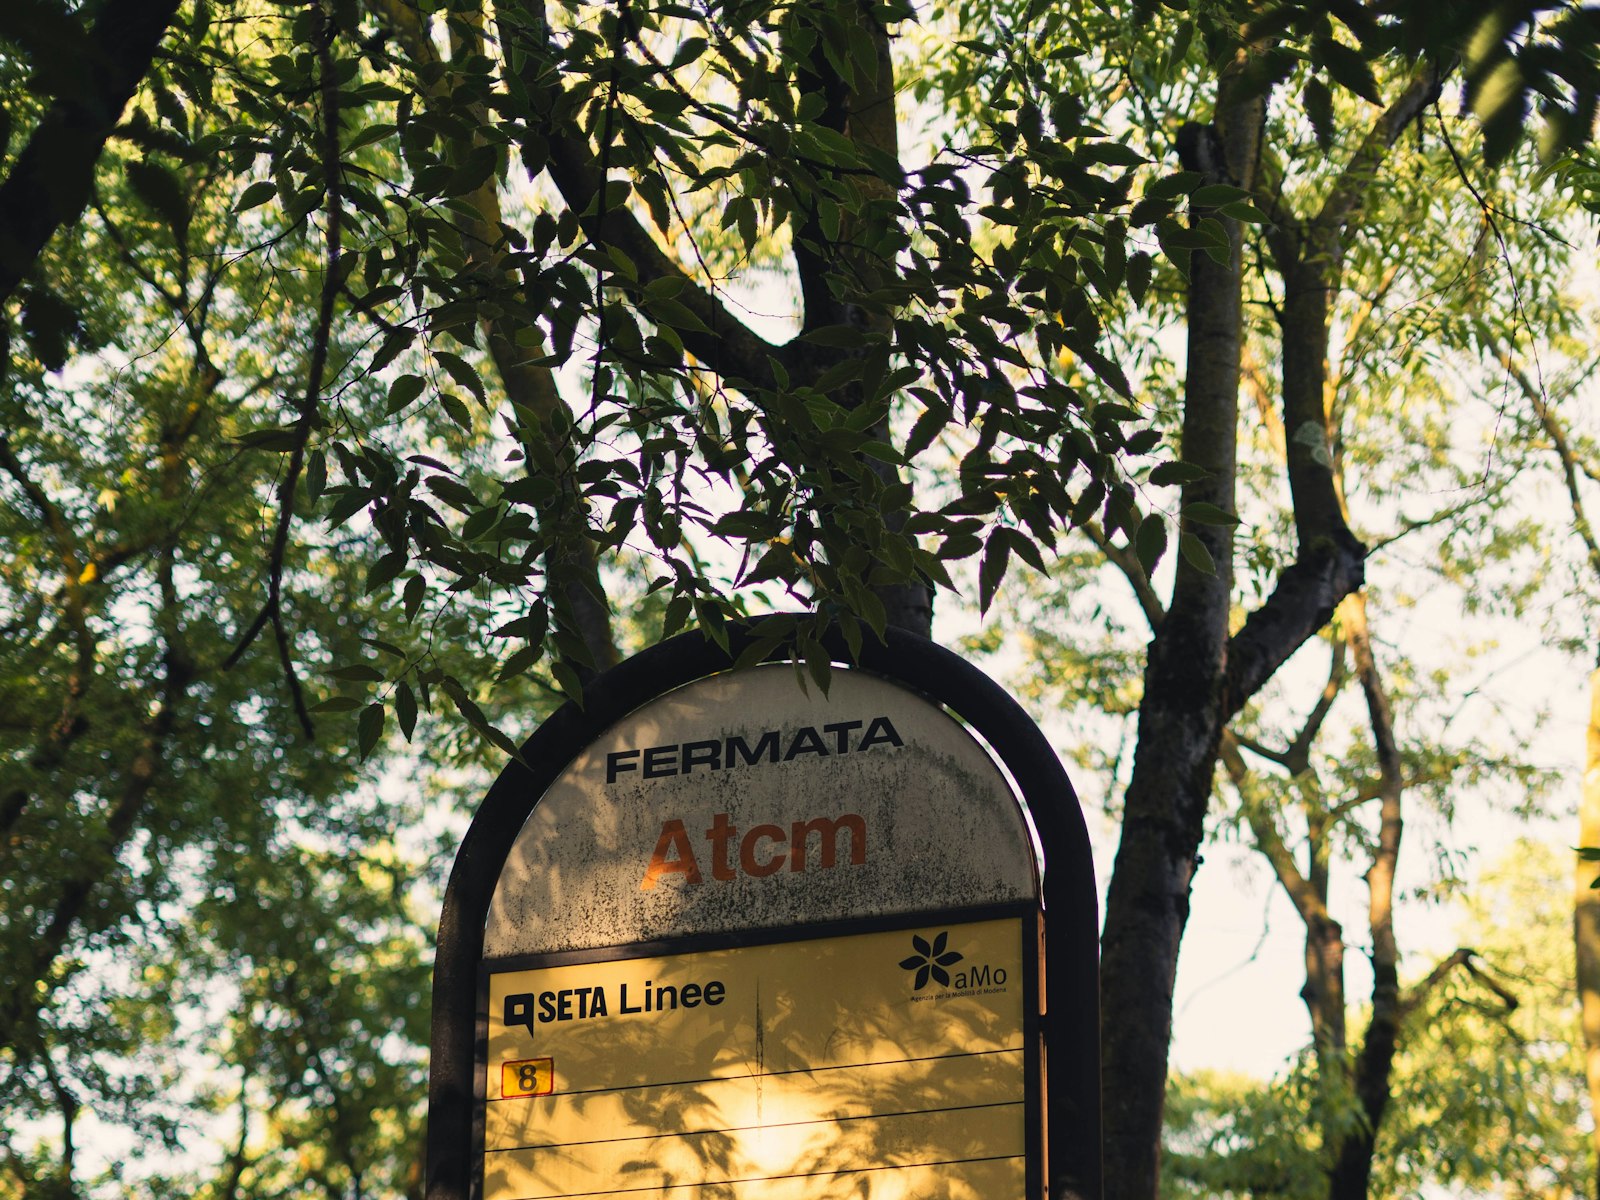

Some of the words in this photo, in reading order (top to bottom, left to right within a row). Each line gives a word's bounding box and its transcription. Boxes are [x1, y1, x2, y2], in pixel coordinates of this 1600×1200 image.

[607, 716, 904, 784] FERMATA
[640, 813, 867, 891] Atcm
[952, 990, 975, 998] Mobilità
[954, 964, 1007, 989] aMo
[538, 986, 608, 1023] SETA
[620, 980, 725, 1015] Linee
[518, 1064, 537, 1091] 8
